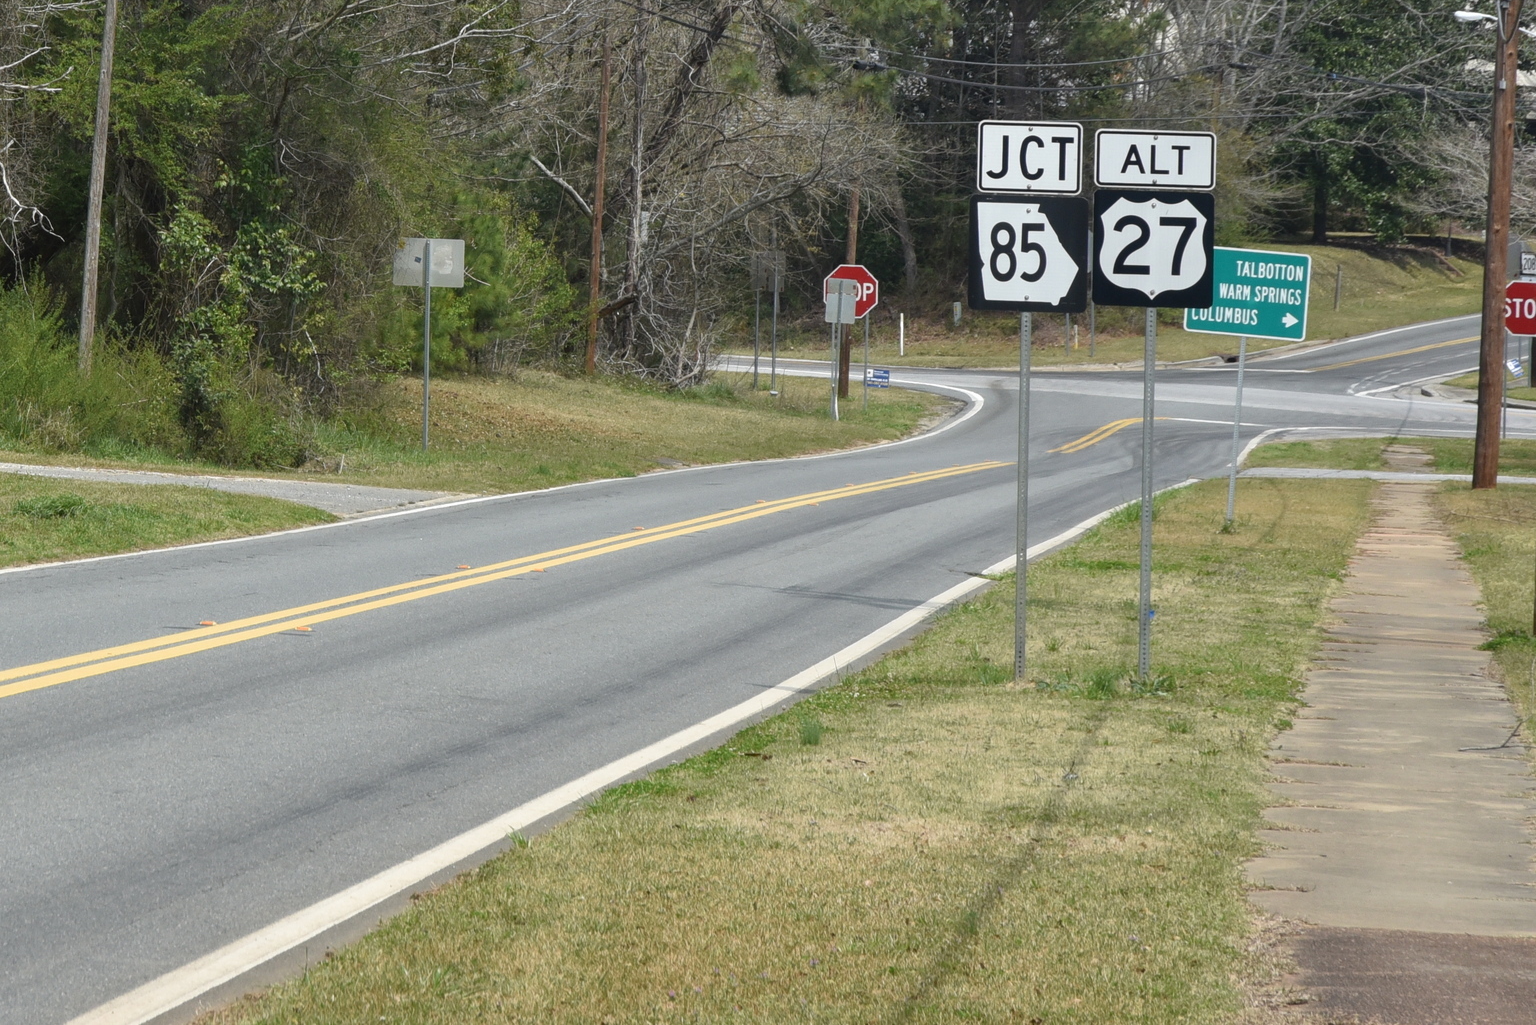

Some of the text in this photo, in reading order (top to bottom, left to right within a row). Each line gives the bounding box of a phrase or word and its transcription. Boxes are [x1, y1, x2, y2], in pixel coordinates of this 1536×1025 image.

[986, 135, 1074, 181] JCT
[1120, 144, 1191, 176] ALT
[989, 221, 1047, 283] 85
[1112, 214, 1197, 276] 27
[1236, 260, 1304, 282] TALBOTTON
[1219, 282, 1302, 306] WARM SPRINGS
[1191, 306, 1258, 326] COLUMBUS
[1505, 298, 1536, 319] STO
